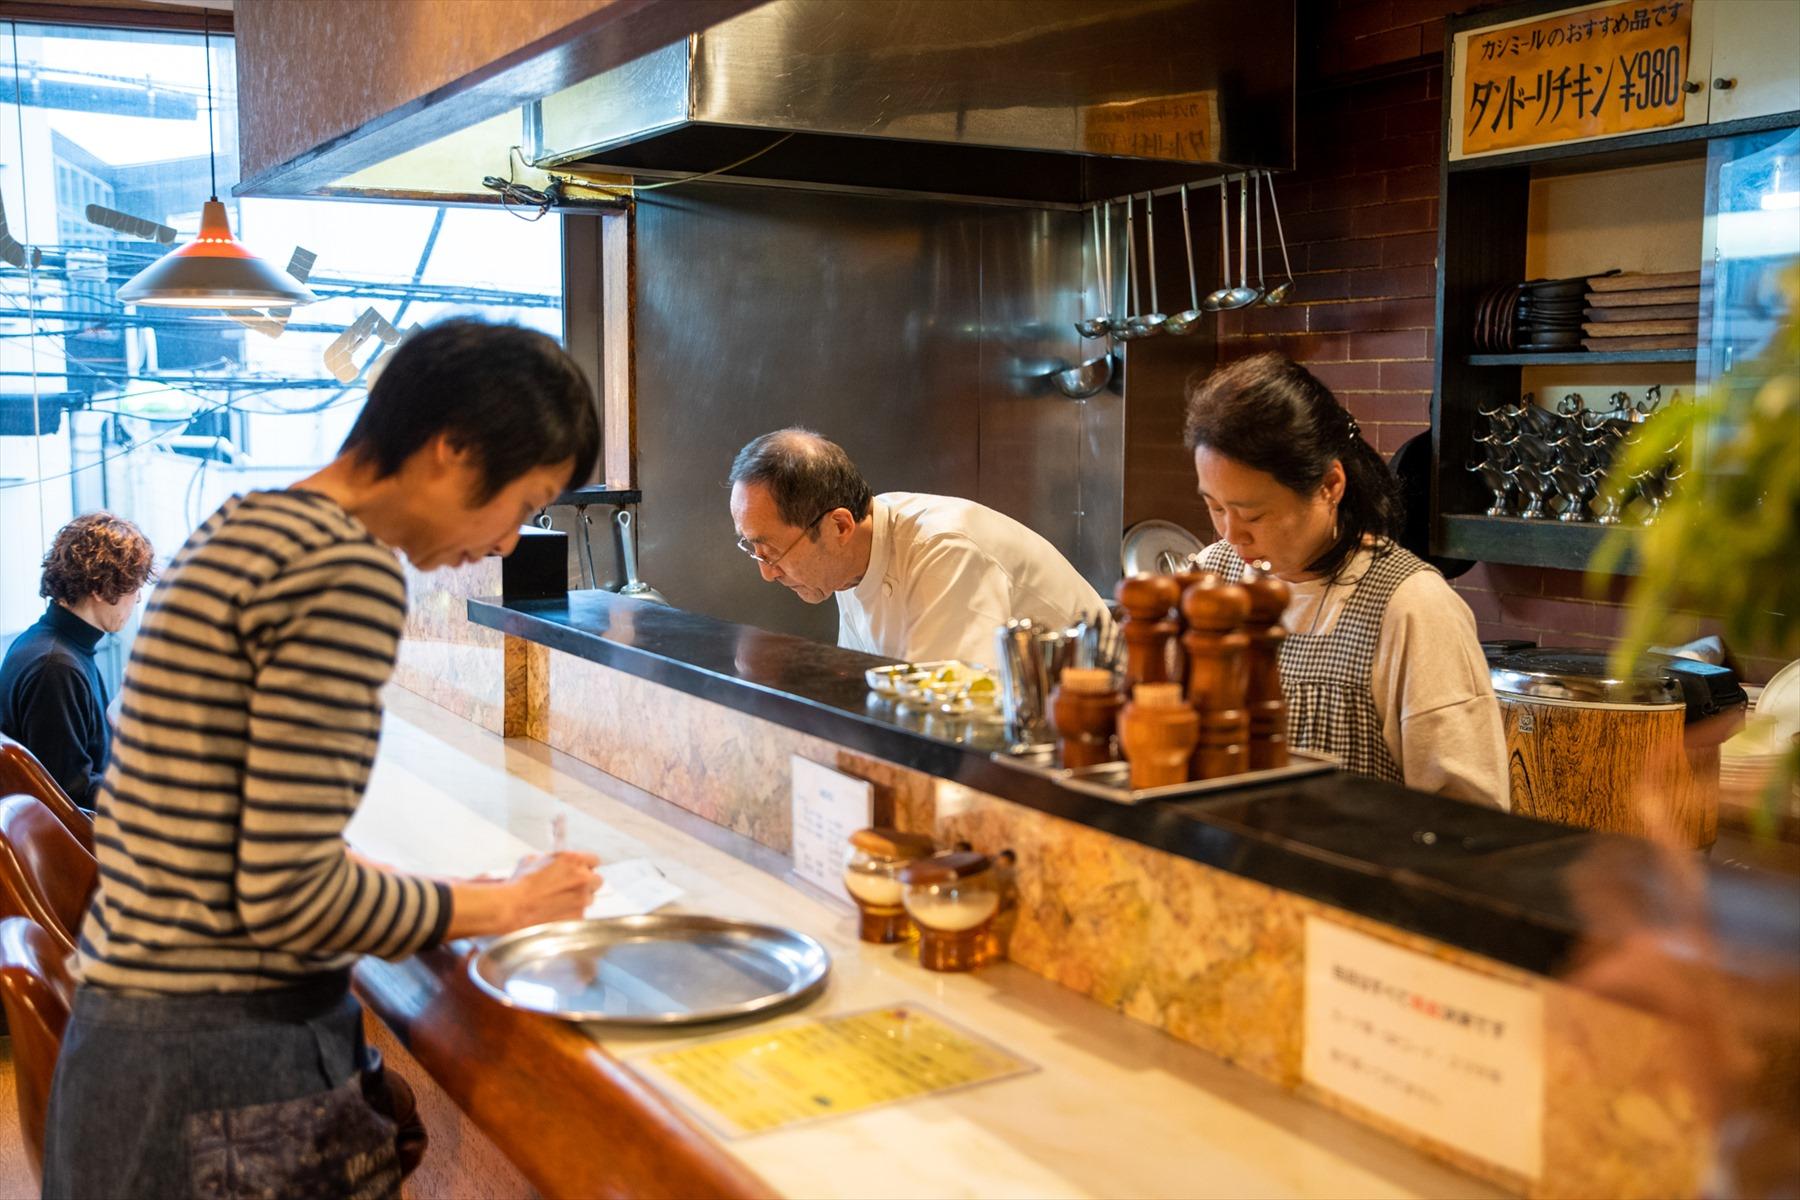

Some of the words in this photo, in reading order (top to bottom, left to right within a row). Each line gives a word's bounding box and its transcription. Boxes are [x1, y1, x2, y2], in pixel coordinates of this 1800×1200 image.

[1481, 2, 1684, 60] カシミールのおすすめ品です
[1468, 57, 1615, 137] タンドーリチキン
[1619, 45, 1680, 112] ¥980
